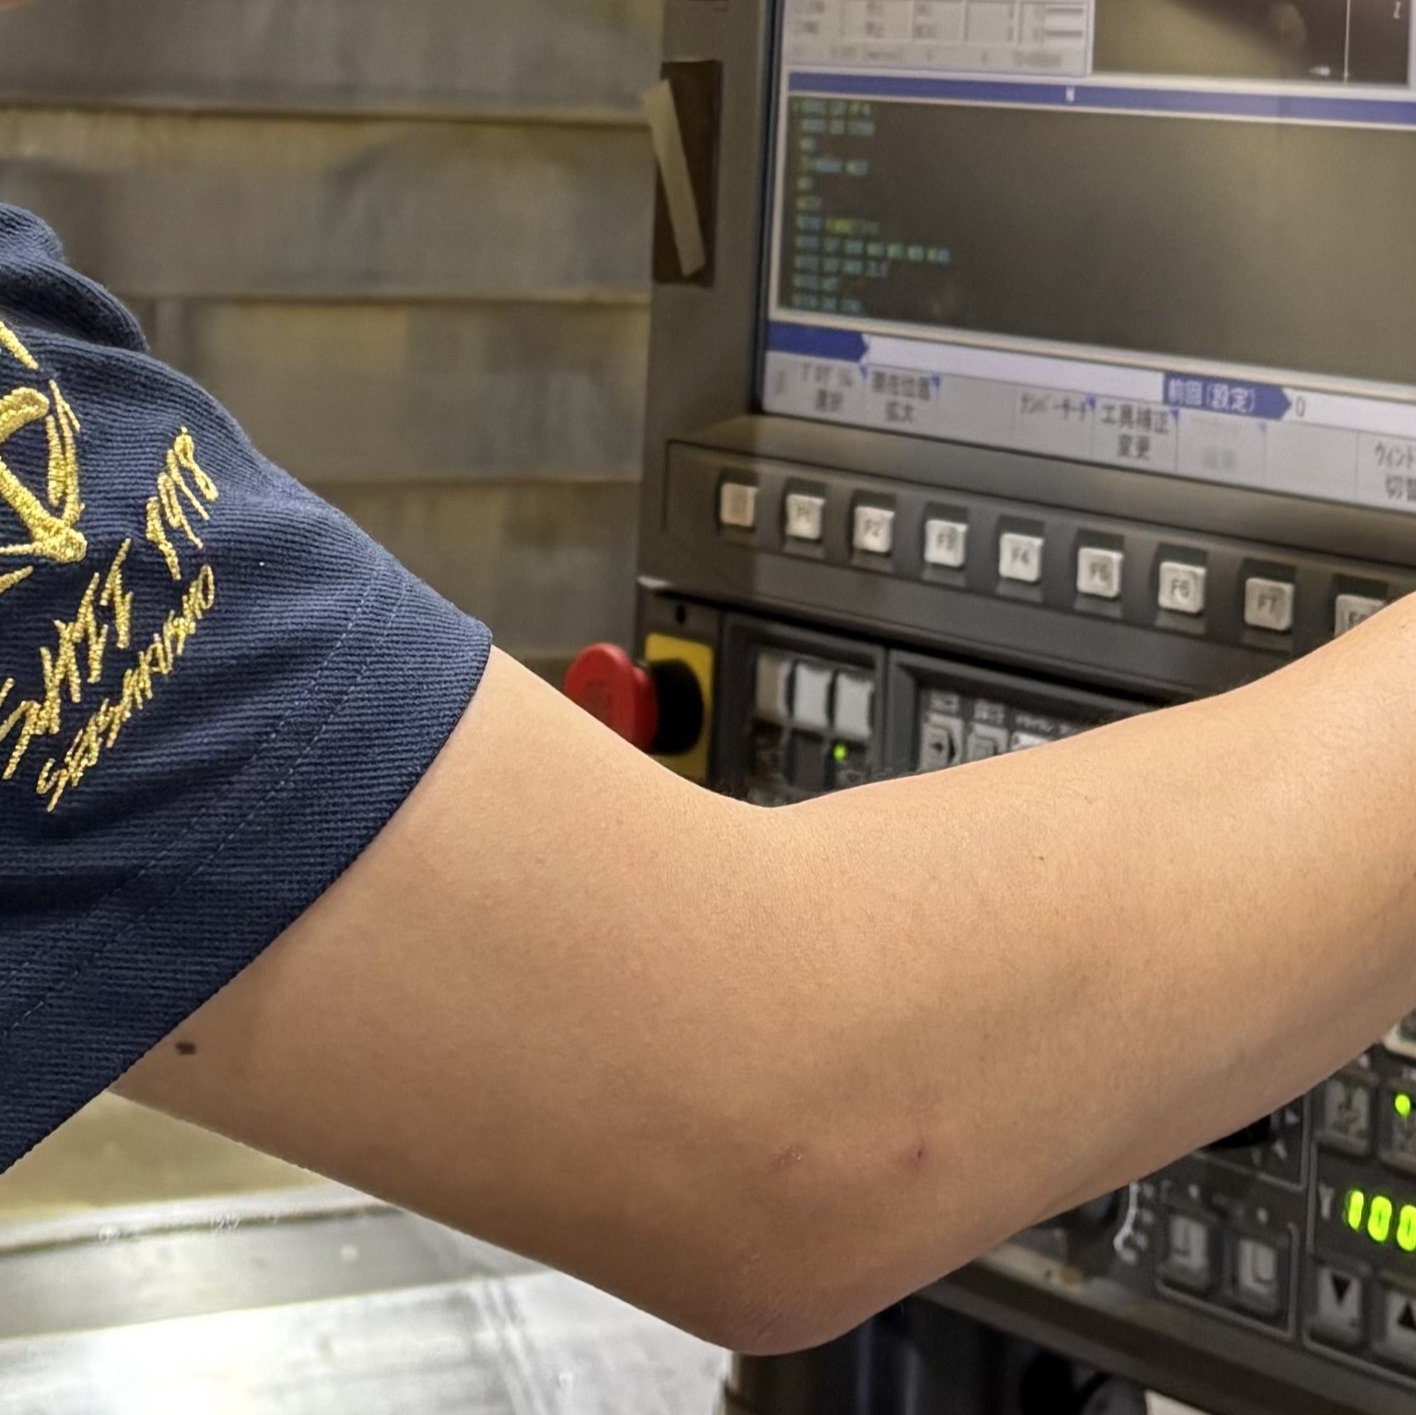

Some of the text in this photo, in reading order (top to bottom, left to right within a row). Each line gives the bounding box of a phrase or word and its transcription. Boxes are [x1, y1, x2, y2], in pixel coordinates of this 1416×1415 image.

[1101, 403, 1169, 434] 工具補正
[864, 518, 881, 537] F2
[1012, 545, 1030, 565] F4
[1258, 593, 1278, 614] F7
